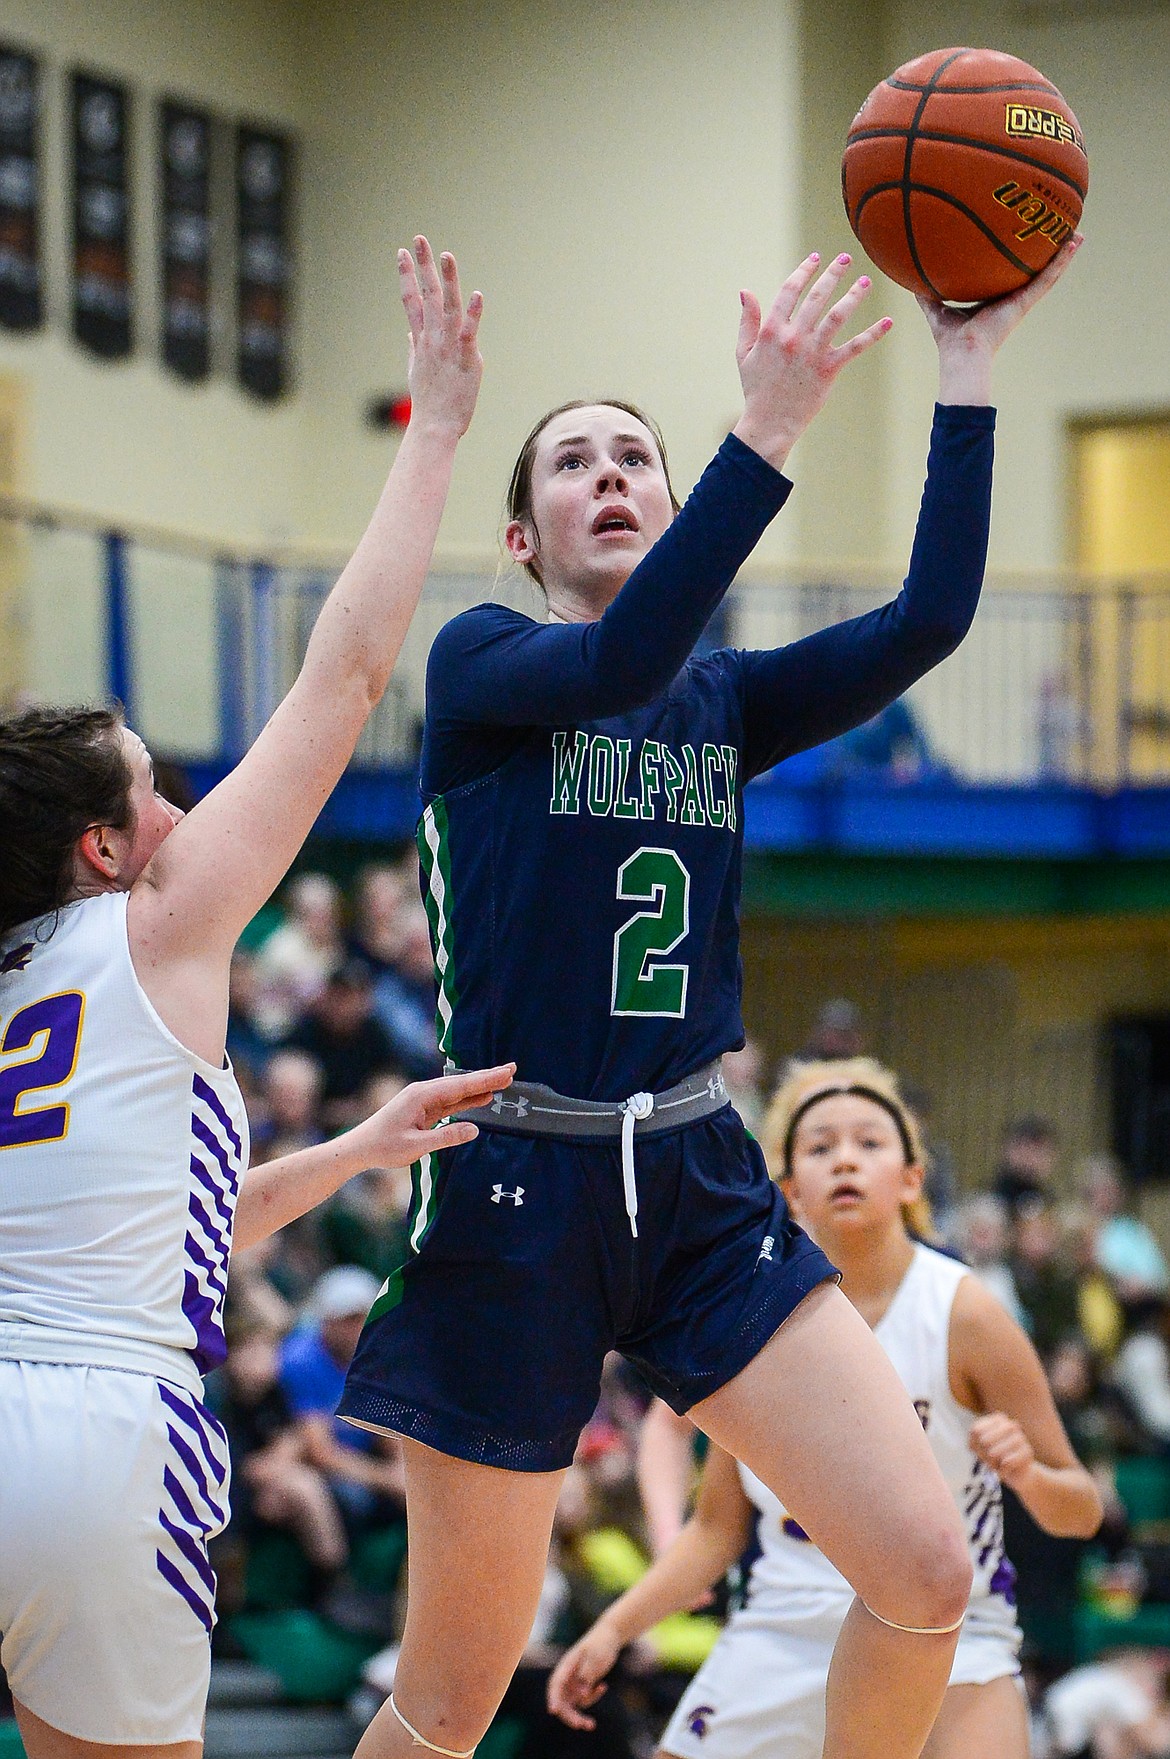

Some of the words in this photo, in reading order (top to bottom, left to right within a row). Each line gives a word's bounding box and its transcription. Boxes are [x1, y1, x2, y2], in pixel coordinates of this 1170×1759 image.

[1011, 107, 1057, 138] PRO
[992, 180, 1074, 247] aden
[550, 730, 738, 834] WOLFPACK
[610, 846, 691, 1019] 2
[0, 988, 86, 1151] 2
